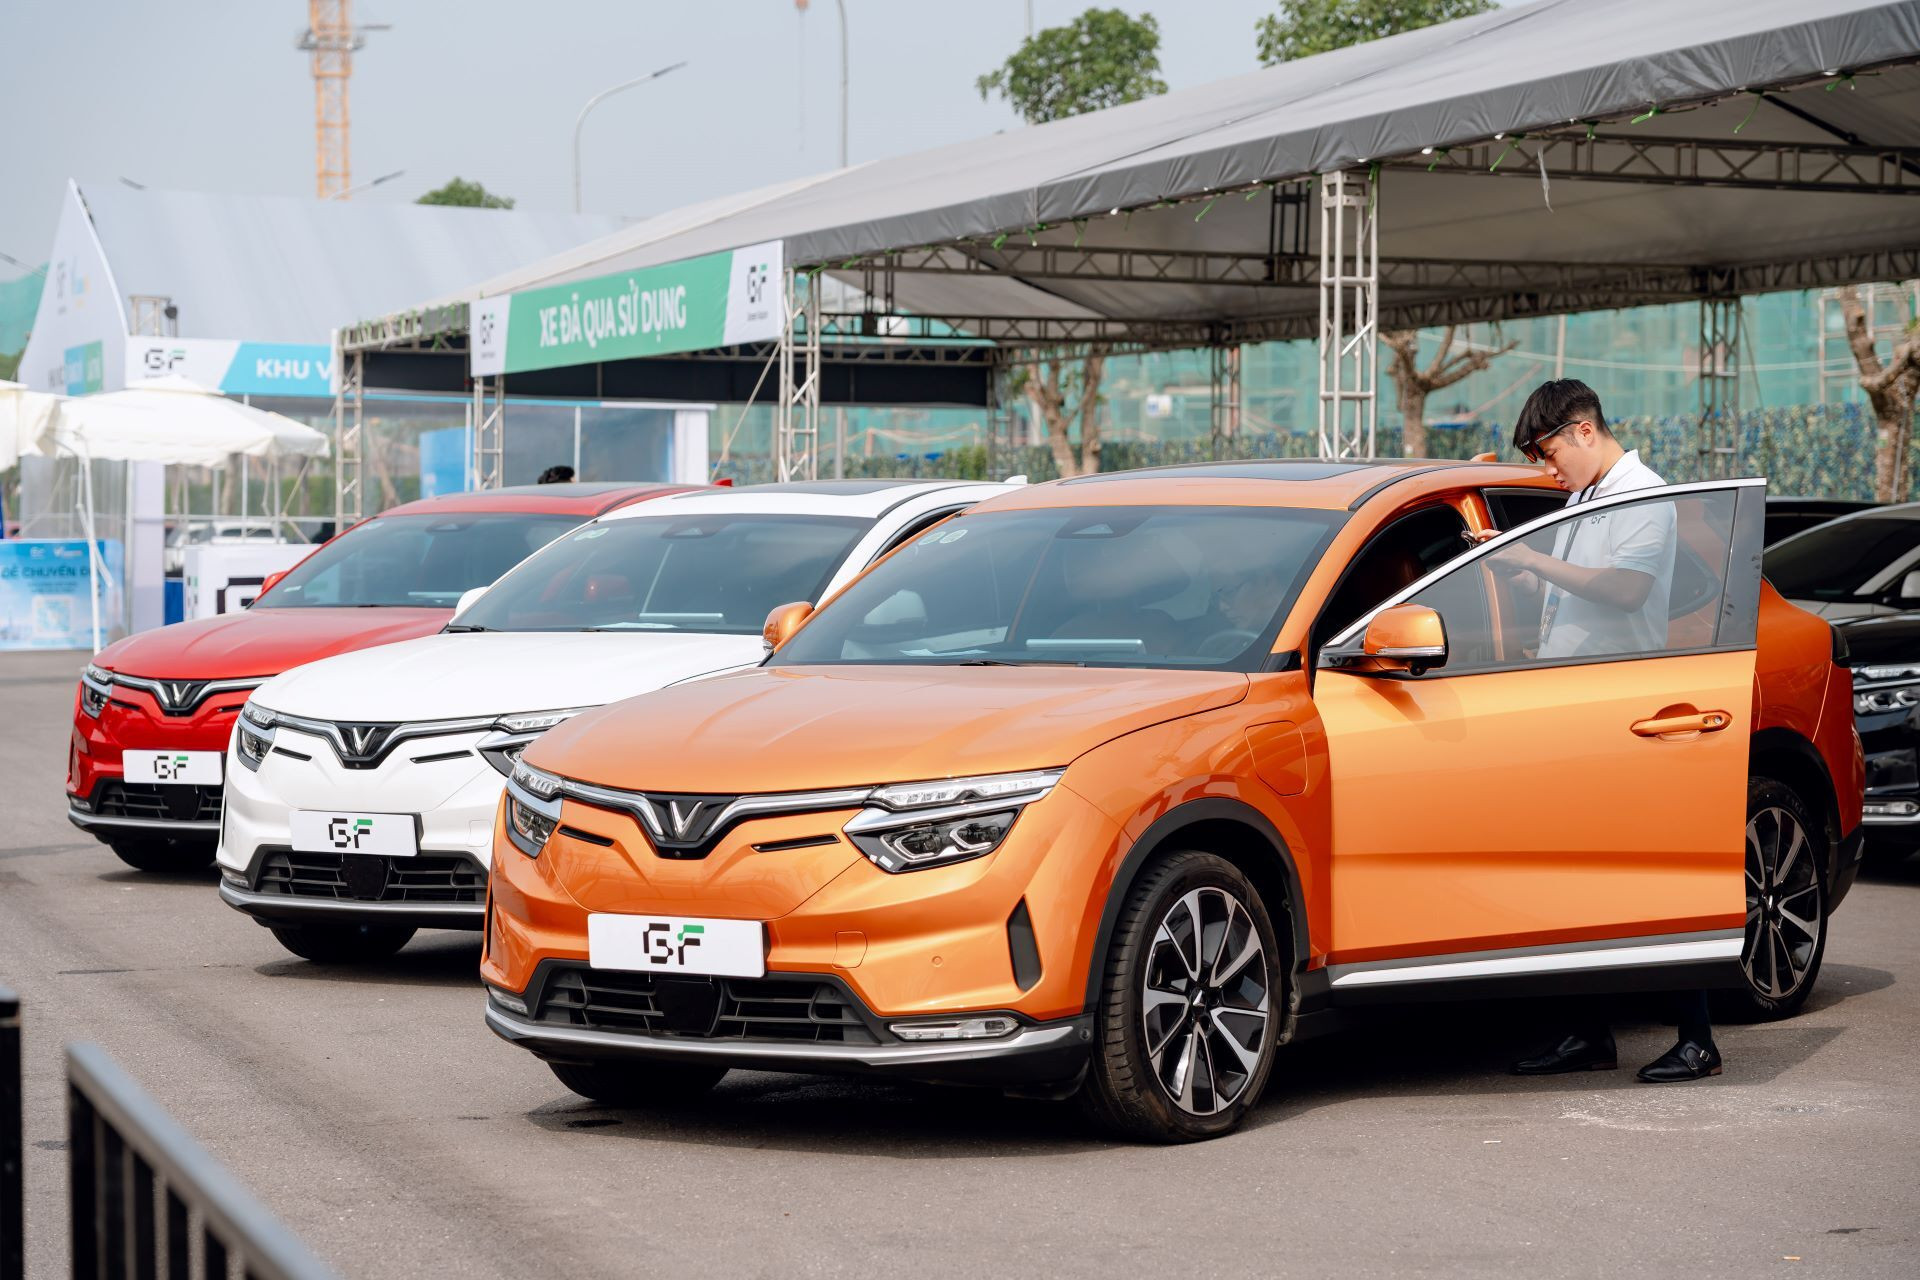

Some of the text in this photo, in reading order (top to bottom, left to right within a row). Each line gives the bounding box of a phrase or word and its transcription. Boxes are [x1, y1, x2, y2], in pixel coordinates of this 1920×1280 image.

[539, 305, 560, 348] XE
[583, 297, 617, 349] QUA
[617, 278, 640, 337] SỬ
[641, 284, 687, 344] DỤNG
[256, 358, 309, 379] KHU
[154, 755, 188, 779] GF
[328, 818, 373, 848] GF
[643, 923, 704, 965] GF
